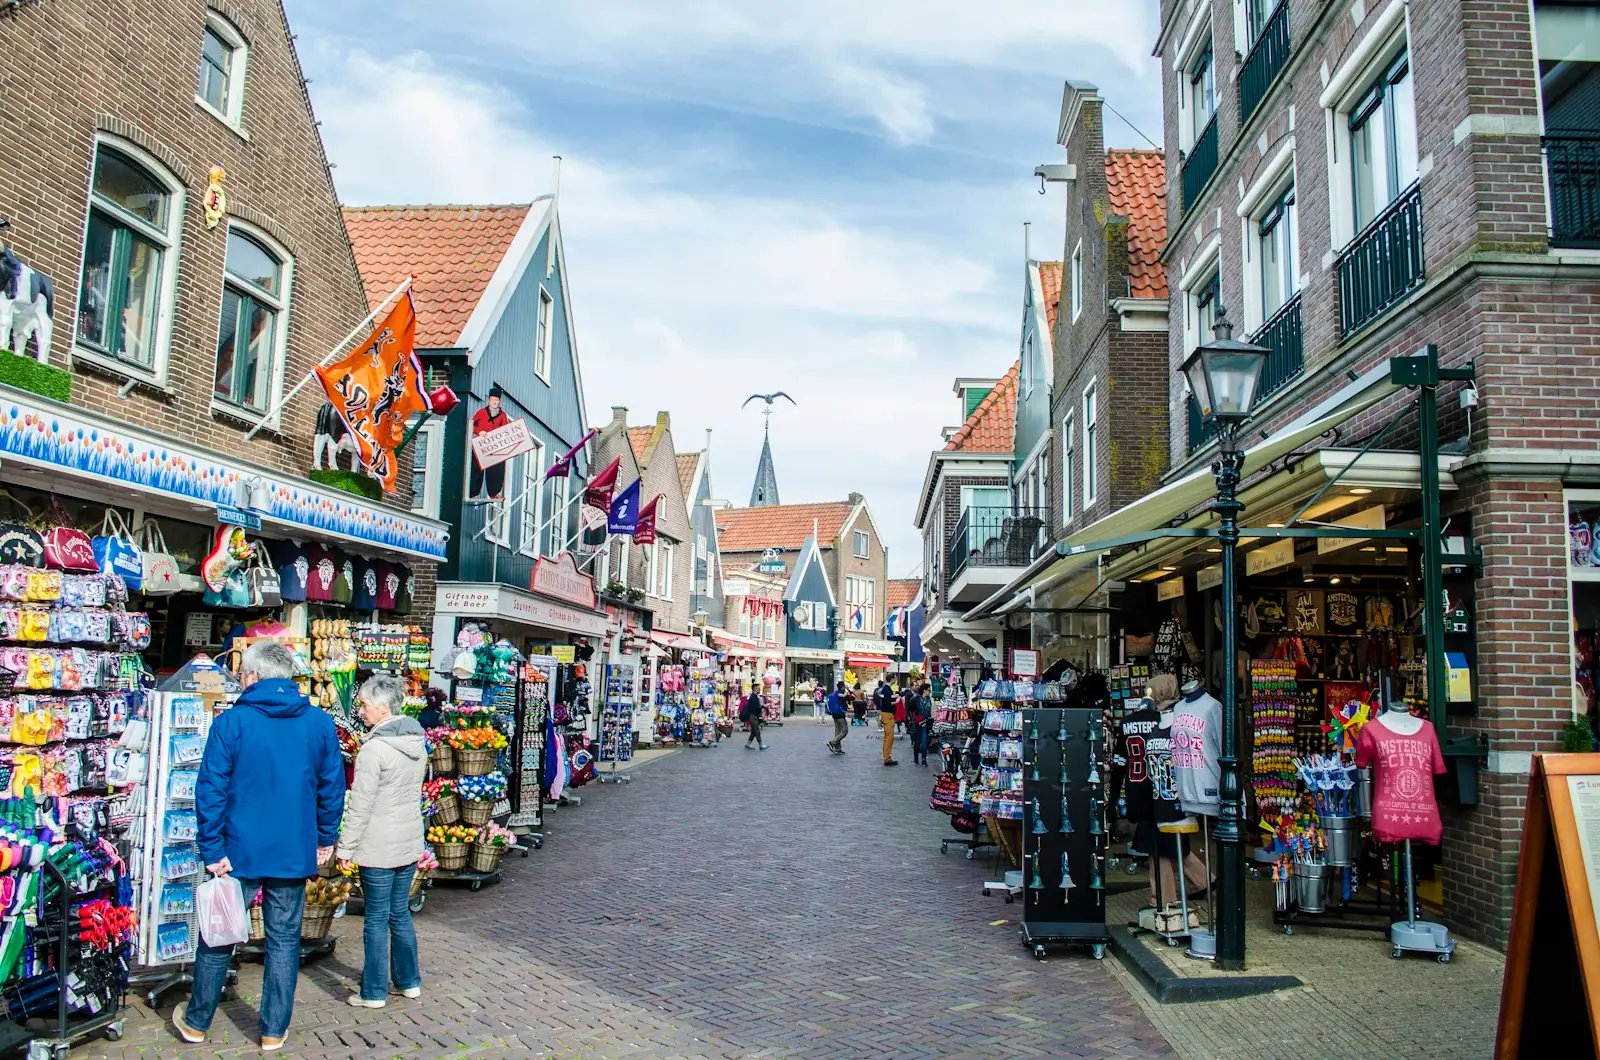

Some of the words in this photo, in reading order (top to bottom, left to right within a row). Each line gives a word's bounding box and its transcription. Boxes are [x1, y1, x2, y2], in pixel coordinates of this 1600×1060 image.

[478, 429, 510, 447] FOTO'S
[510, 424, 522, 434] IN
[480, 432, 525, 455] KOSTUUM
[610, 523, 636, 531] Informatie
[445, 592, 489, 601] Giftshop
[1327, 592, 1358, 606] AMSTERDAM
[513, 600, 538, 615] Souvenirs
[1122, 721, 1158, 735] AMSTER
[1172, 713, 1205, 734] STERDAM
[1192, 738, 1203, 749] 75
[1125, 735, 1148, 782] 8
[1388, 753, 1426, 769] CITY
